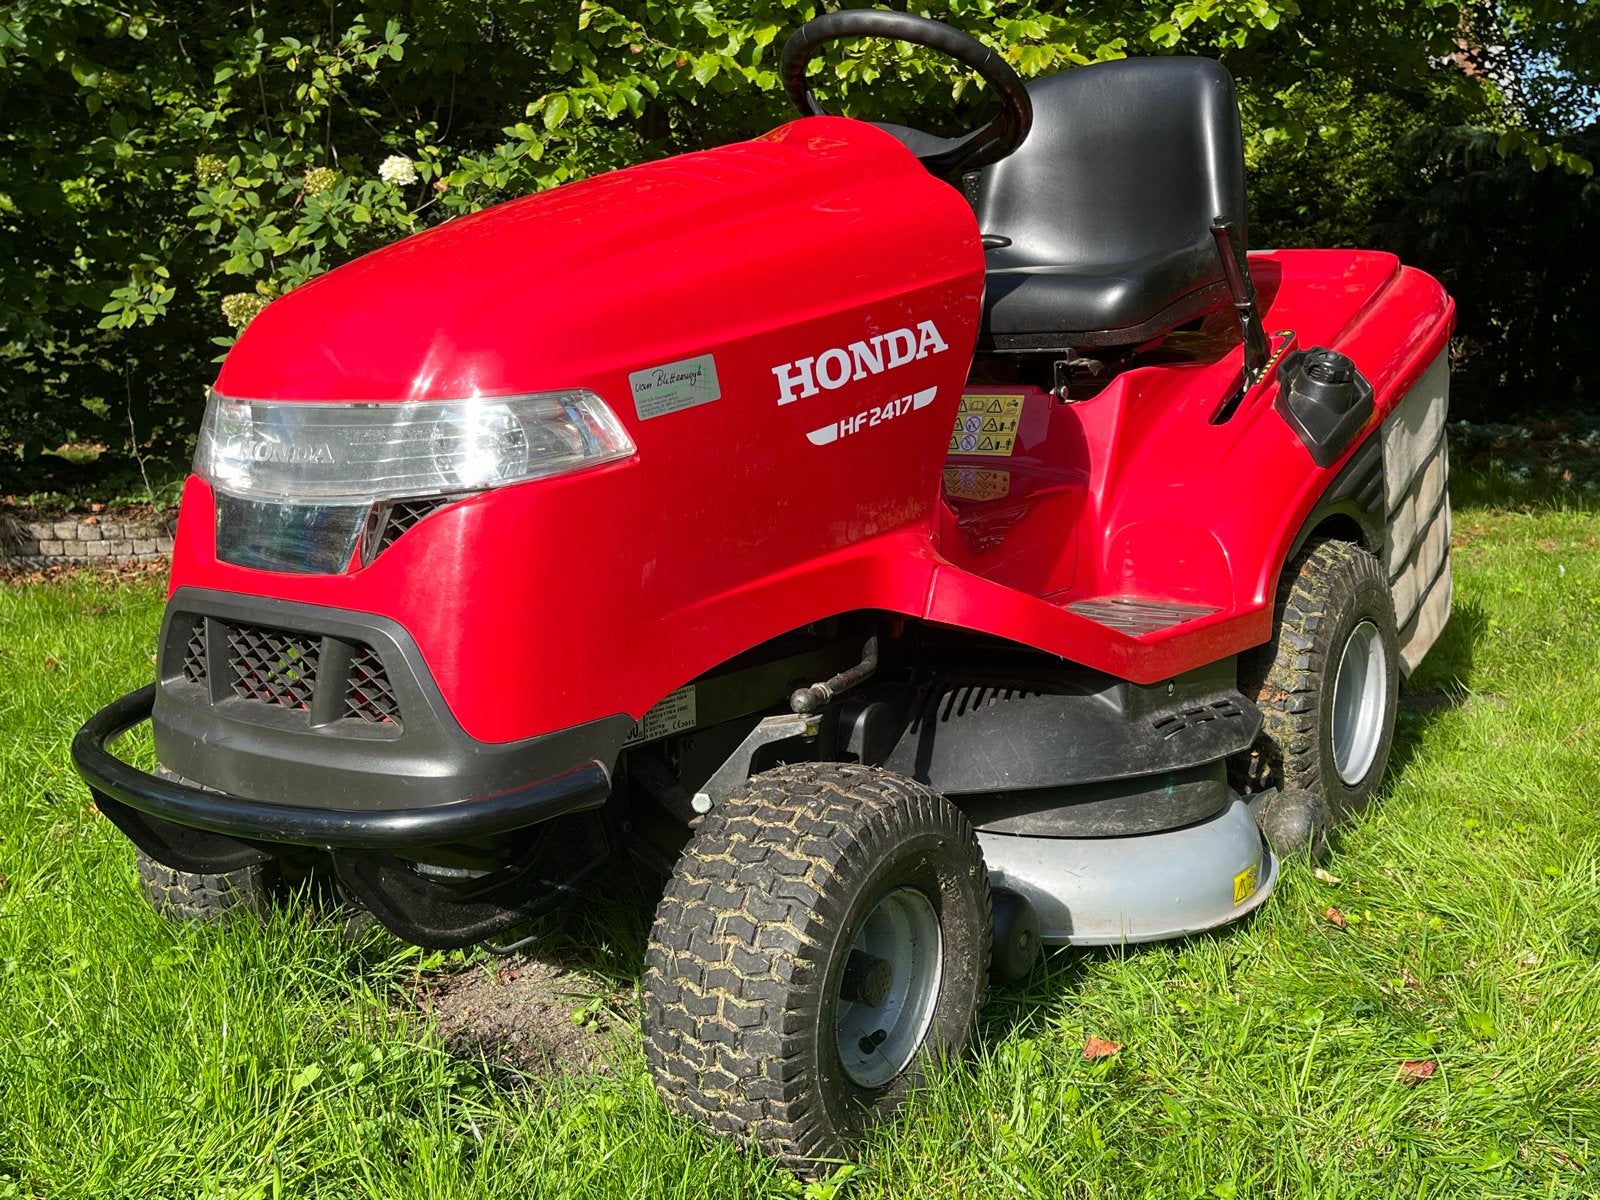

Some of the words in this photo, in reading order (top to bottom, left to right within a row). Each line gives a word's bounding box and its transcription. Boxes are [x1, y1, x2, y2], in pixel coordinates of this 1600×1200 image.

[771, 319, 949, 406] HONDA
[840, 411, 868, 438] HF
[869, 395, 913, 427] 2417
[239, 440, 335, 464] HONDA
